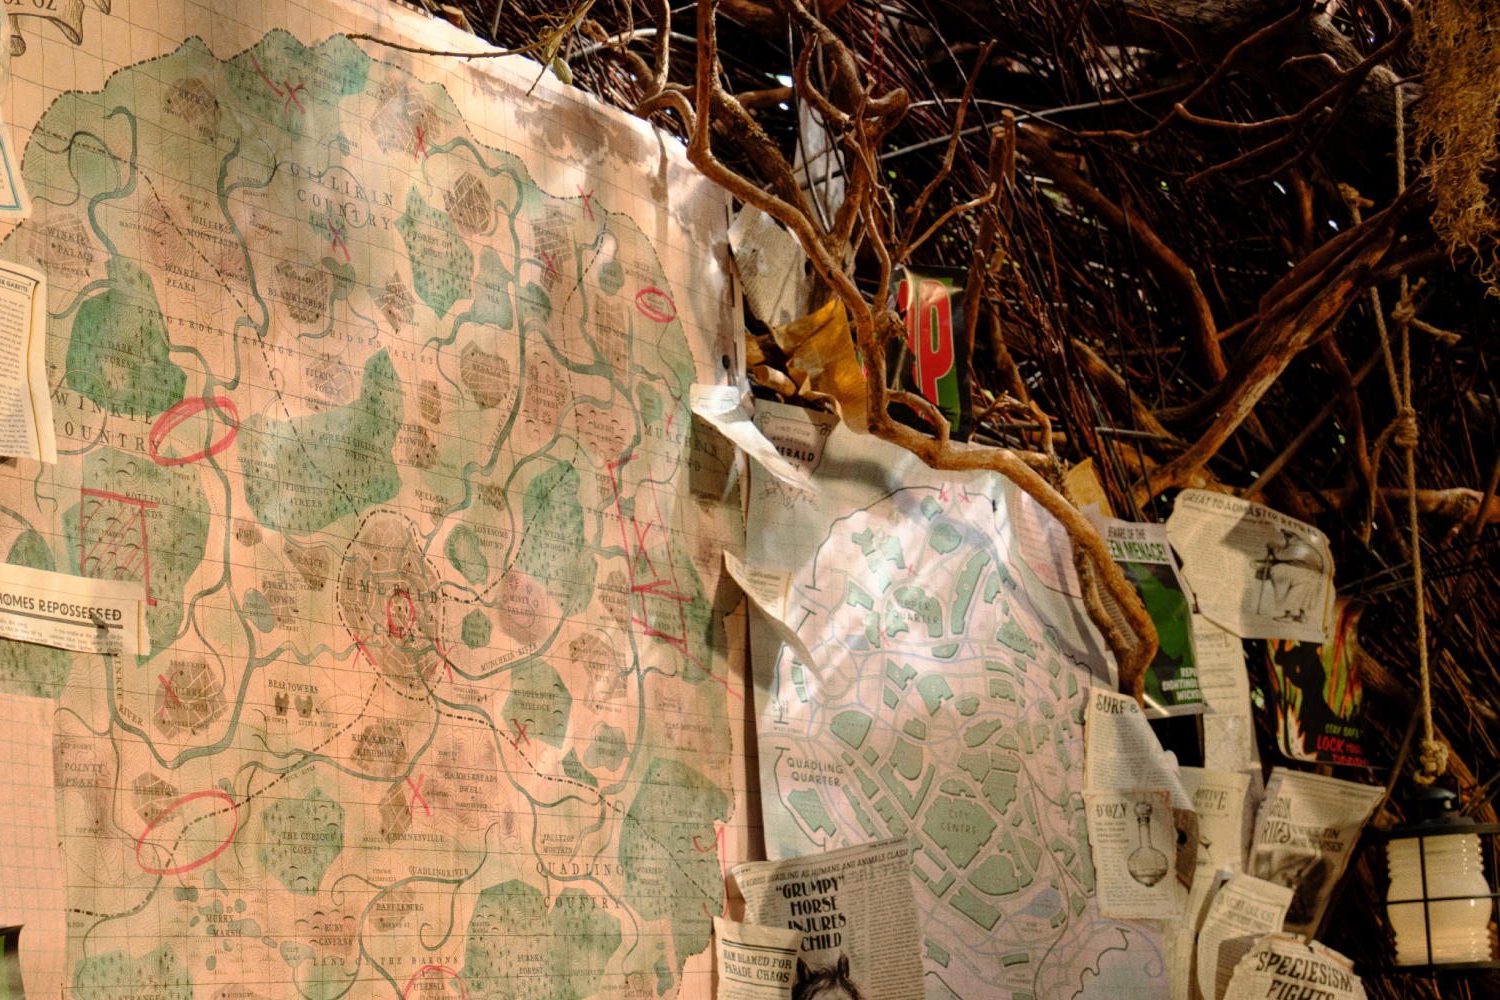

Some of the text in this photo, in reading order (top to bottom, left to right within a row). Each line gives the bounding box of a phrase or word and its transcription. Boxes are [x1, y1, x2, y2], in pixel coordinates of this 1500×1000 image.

[290, 161, 393, 207] GILLIKIN
[296, 188, 391, 231] COUNTRY
[165, 277, 197, 293] PEAKS
[137, 305, 224, 338] DANGEROUS
[1124, 541, 1170, 563] MENACE!
[38, 598, 123, 622] REPOSSESSED
[287, 682, 320, 695] TOWERS
[165, 701, 209, 714] KINGDOM
[1095, 693, 1127, 714] SURF
[117, 703, 145, 727] RIVER
[1324, 723, 1342, 736] STAY
[1316, 735, 1344, 755] LOCK
[63, 762, 105, 774] POINTY
[786, 757, 844, 775] QUADLING
[65, 778, 100, 789] PEAKS
[790, 771, 842, 788] QUARTER
[949, 809, 971, 820] CITY
[300, 832, 336, 842] CURIOUS
[940, 822, 977, 835] CENTRE
[857, 854, 887, 867] ANIMALS
[886, 848, 909, 861] CLASH
[408, 865, 447, 878] QUADLING
[790, 895, 840, 917] HORSE
[205, 914, 235, 924] MURKY
[788, 912, 848, 933] INJURES
[212, 928, 242, 938] MARSH
[800, 931, 843, 952] CHILD
[517, 953, 545, 963] EUREKA
[737, 952, 770, 967] BLAMED
[772, 957, 793, 970] FOR
[518, 967, 545, 975] FOREST
[756, 968, 791, 983] CHAOS
[1255, 950, 1354, 993] SPECIESISM
